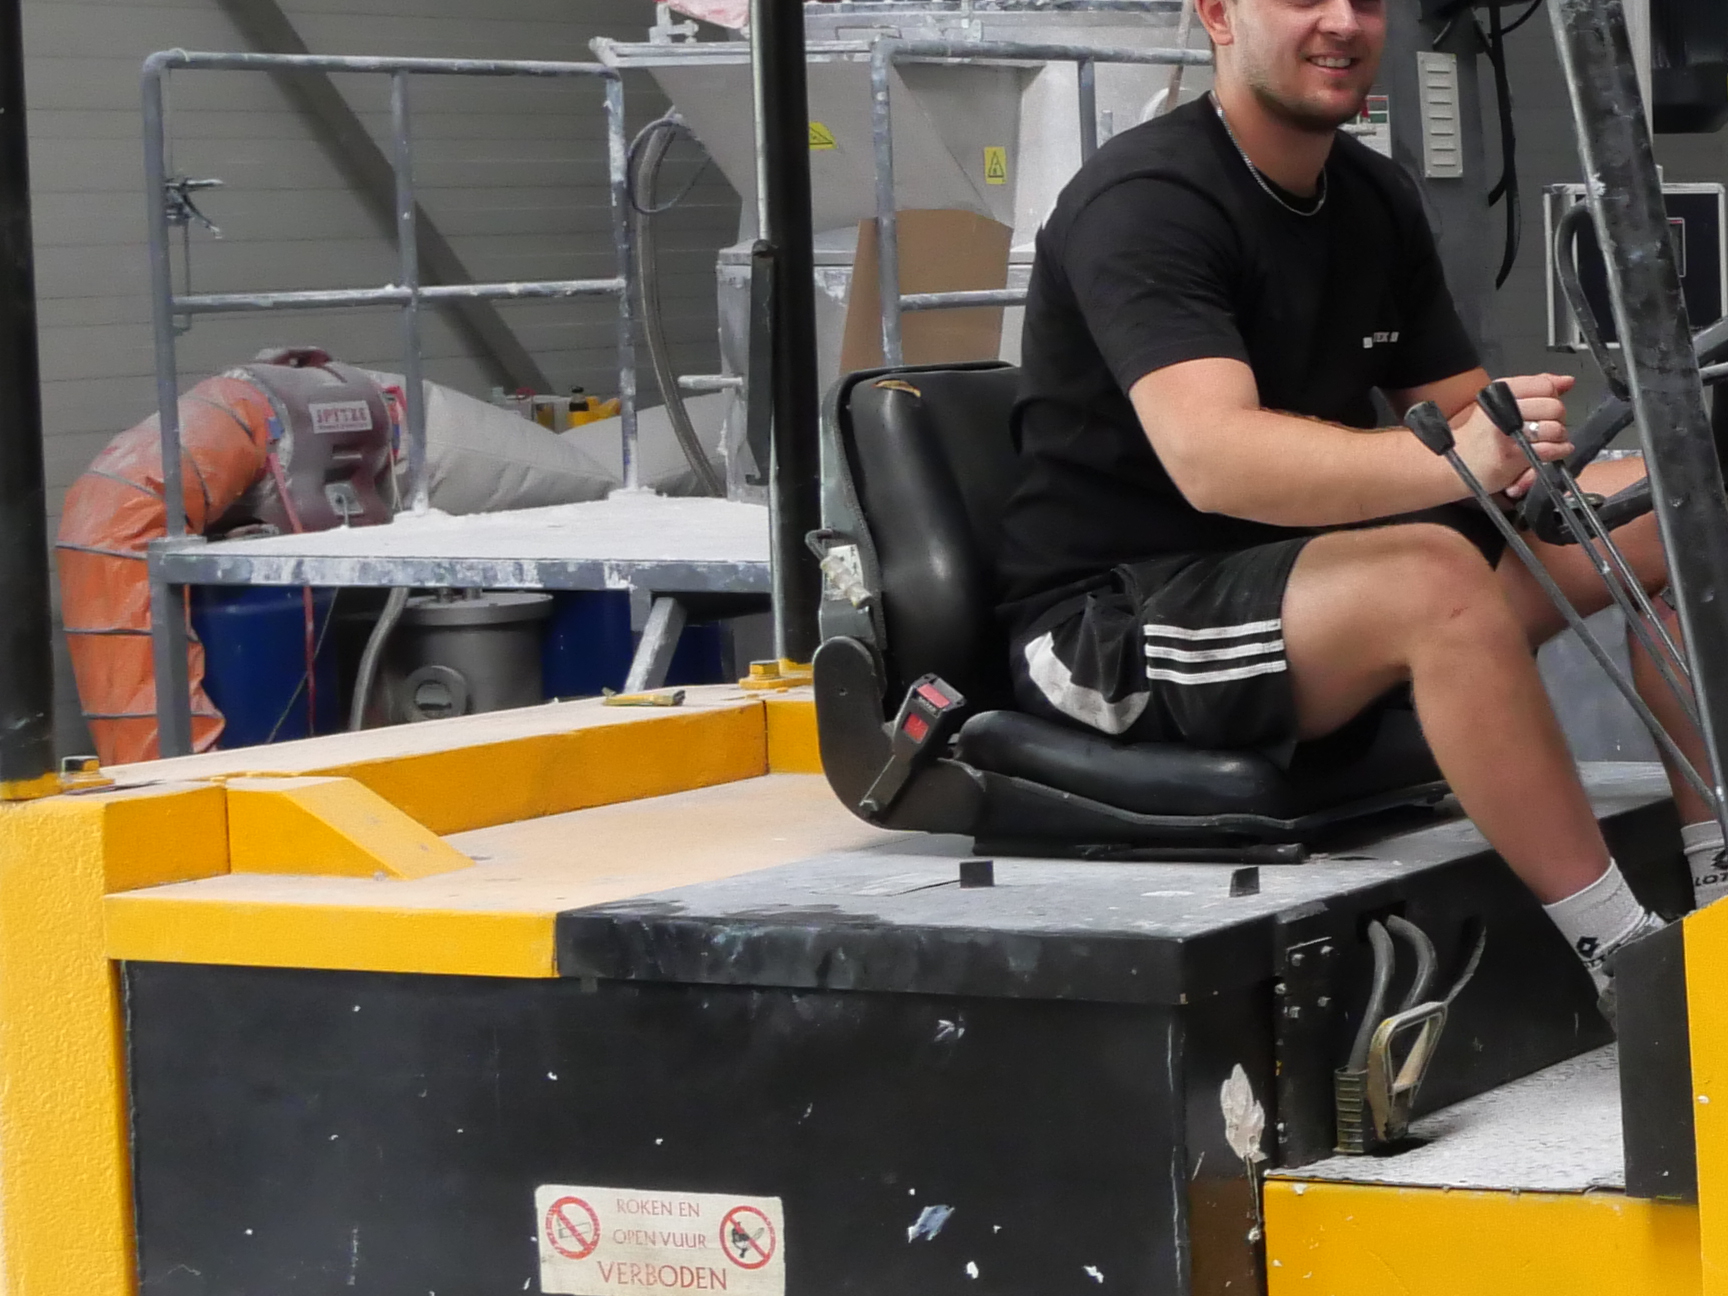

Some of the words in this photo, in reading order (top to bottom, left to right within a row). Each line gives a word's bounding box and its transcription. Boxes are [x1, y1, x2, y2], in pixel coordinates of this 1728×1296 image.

[616, 1198, 673, 1216] ROKEN
[678, 1201, 700, 1218] EN
[612, 1228, 656, 1246] OPEN
[659, 1231, 707, 1249] VUUR
[596, 1260, 727, 1290] VERBODEN
